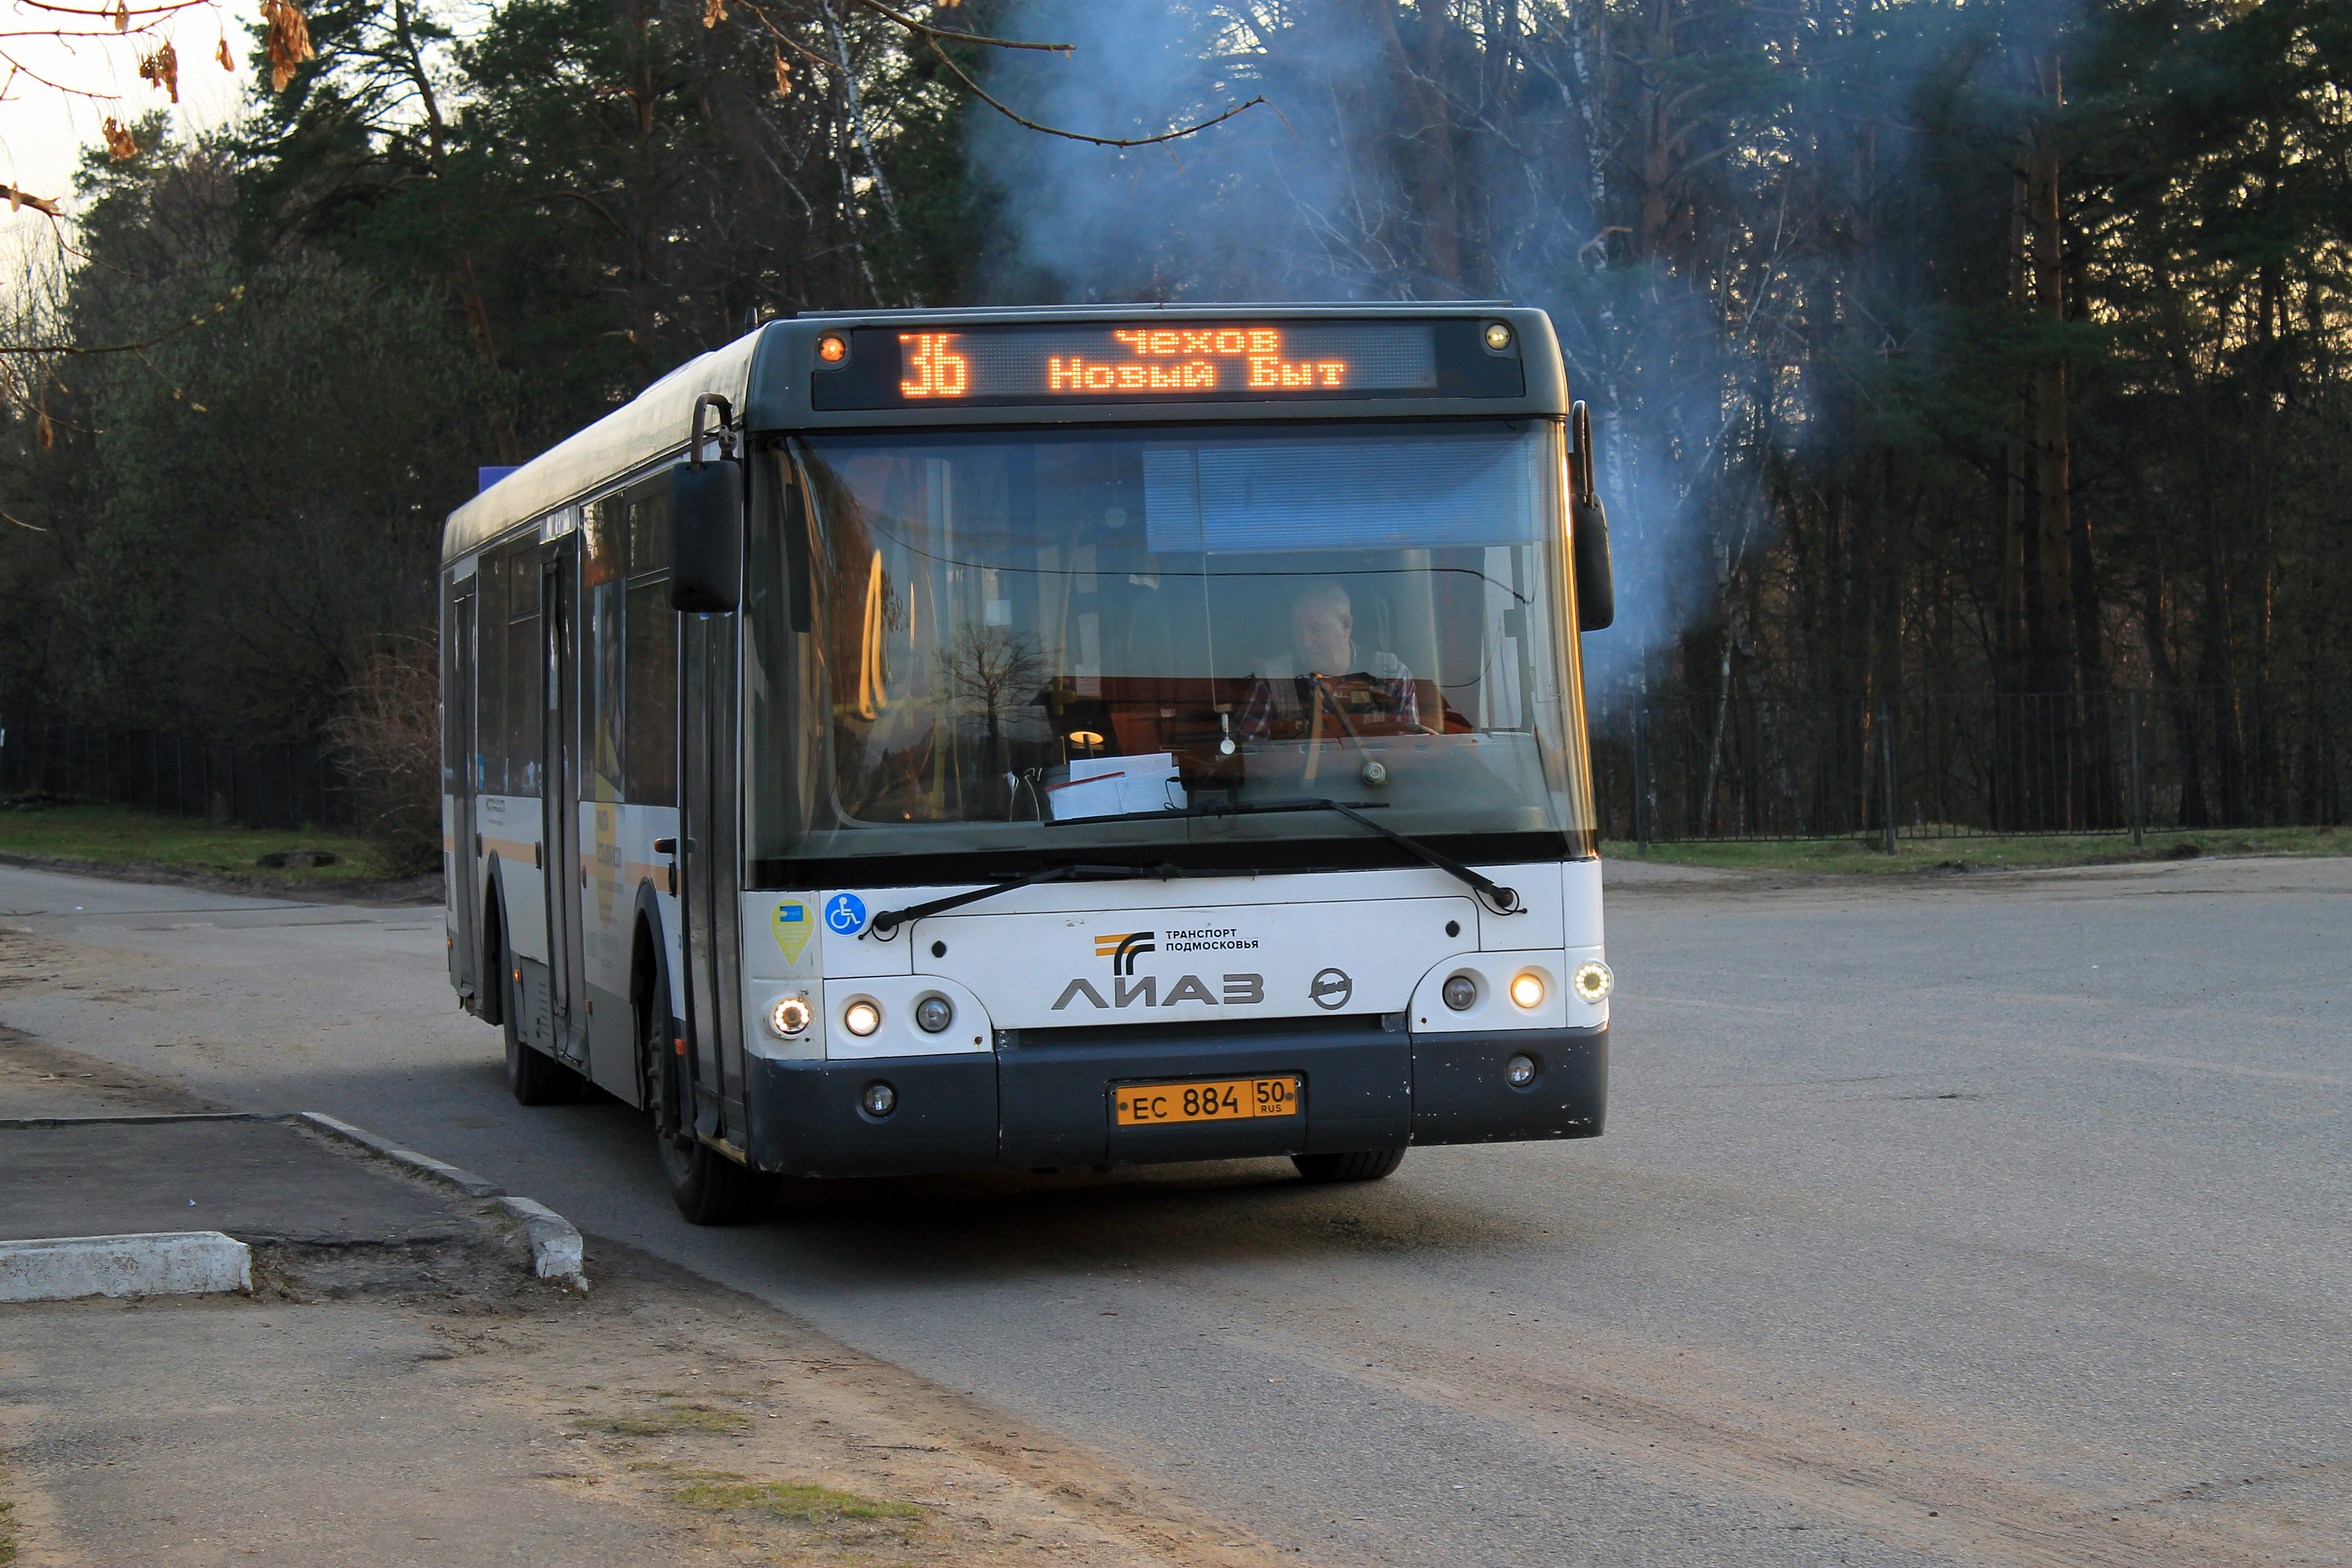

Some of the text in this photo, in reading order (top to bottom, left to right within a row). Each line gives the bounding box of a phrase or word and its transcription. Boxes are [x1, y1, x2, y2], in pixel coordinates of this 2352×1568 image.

[1116, 329, 1278, 354] Чехов
[899, 334, 966, 395] 36
[1050, 355, 1344, 389] Новый Быт
[1166, 928, 1237, 940] ТРАНСПОРТ
[1166, 940, 1259, 952] ПОДМОСКОВЬЯ
[1051, 973, 1265, 1010] ЛИАЗ
[1183, 1086, 1238, 1117] 884
[1256, 1081, 1285, 1103] 50
[1261, 1104, 1282, 1113] RUS
